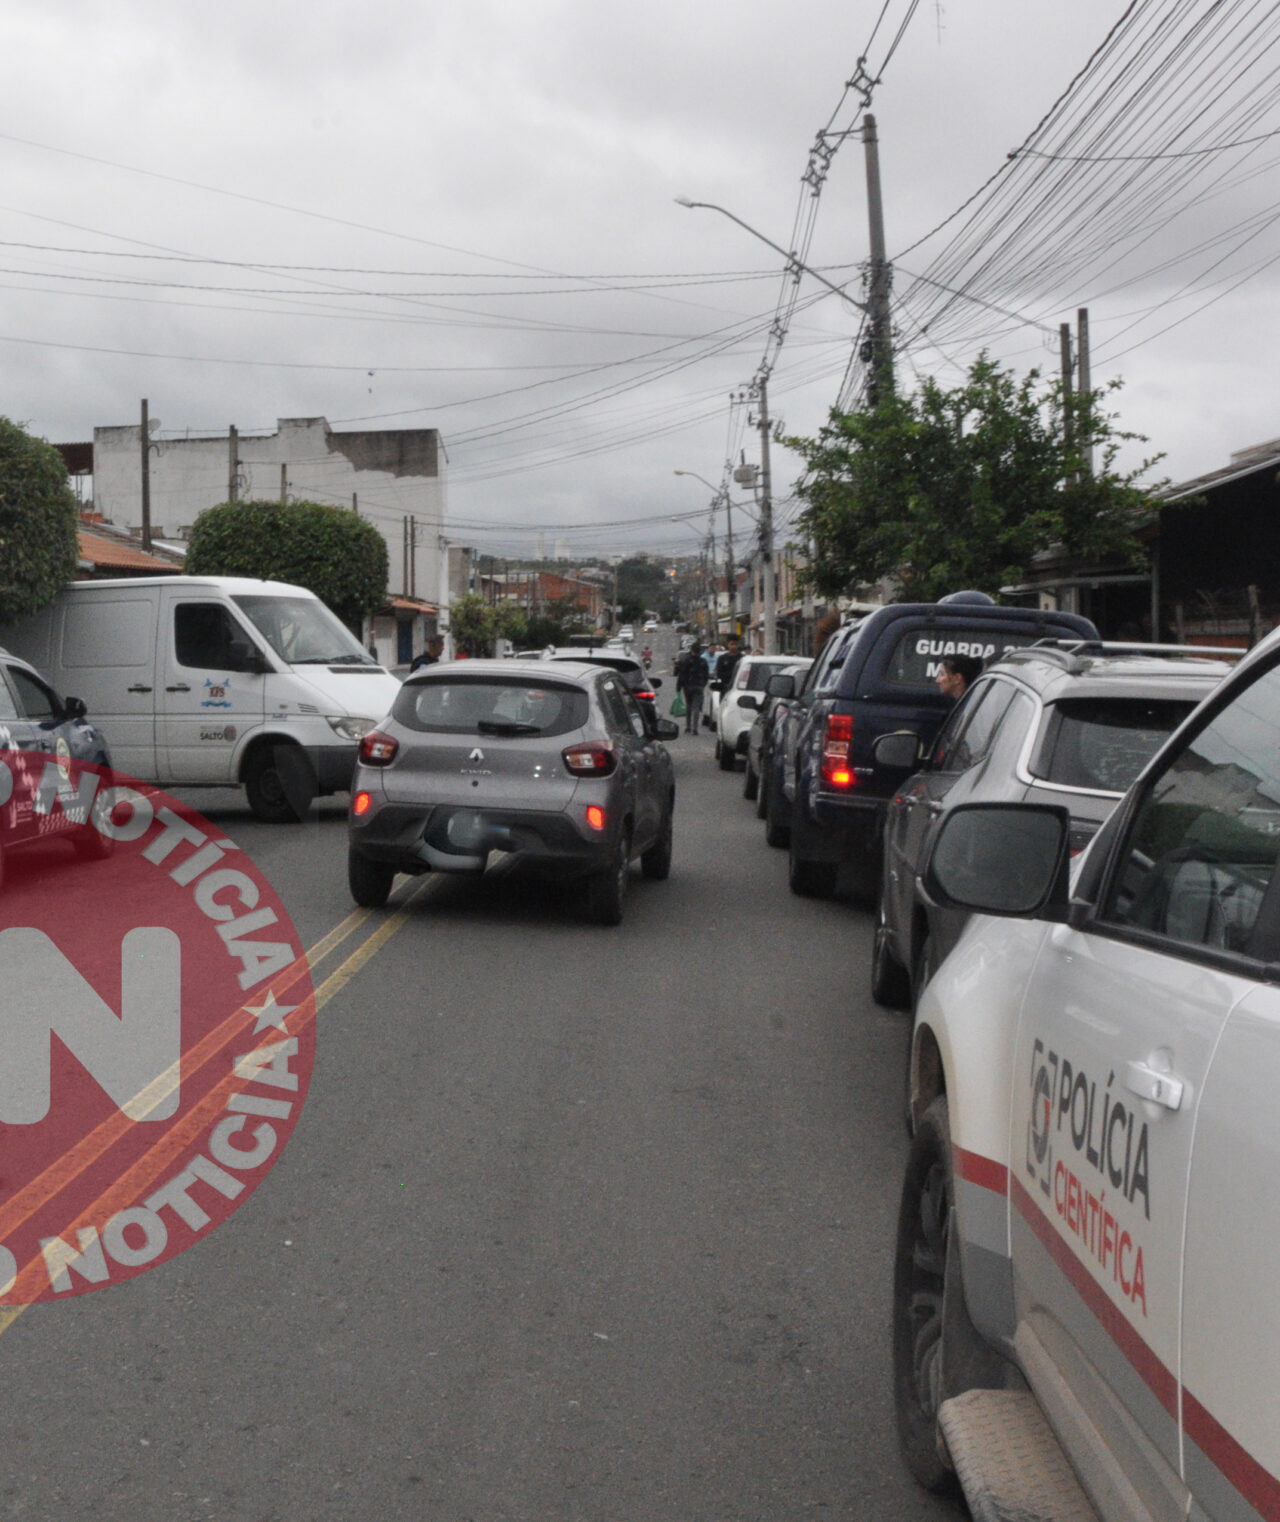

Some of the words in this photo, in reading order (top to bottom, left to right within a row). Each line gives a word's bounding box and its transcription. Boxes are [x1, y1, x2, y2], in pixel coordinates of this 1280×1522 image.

[916, 639, 995, 659] GUARDA
[200, 732, 224, 740] SALTO
[1057, 1058, 1150, 1221] POLÍCIA
[1054, 1160, 1147, 1318] CIENTÍFICA
